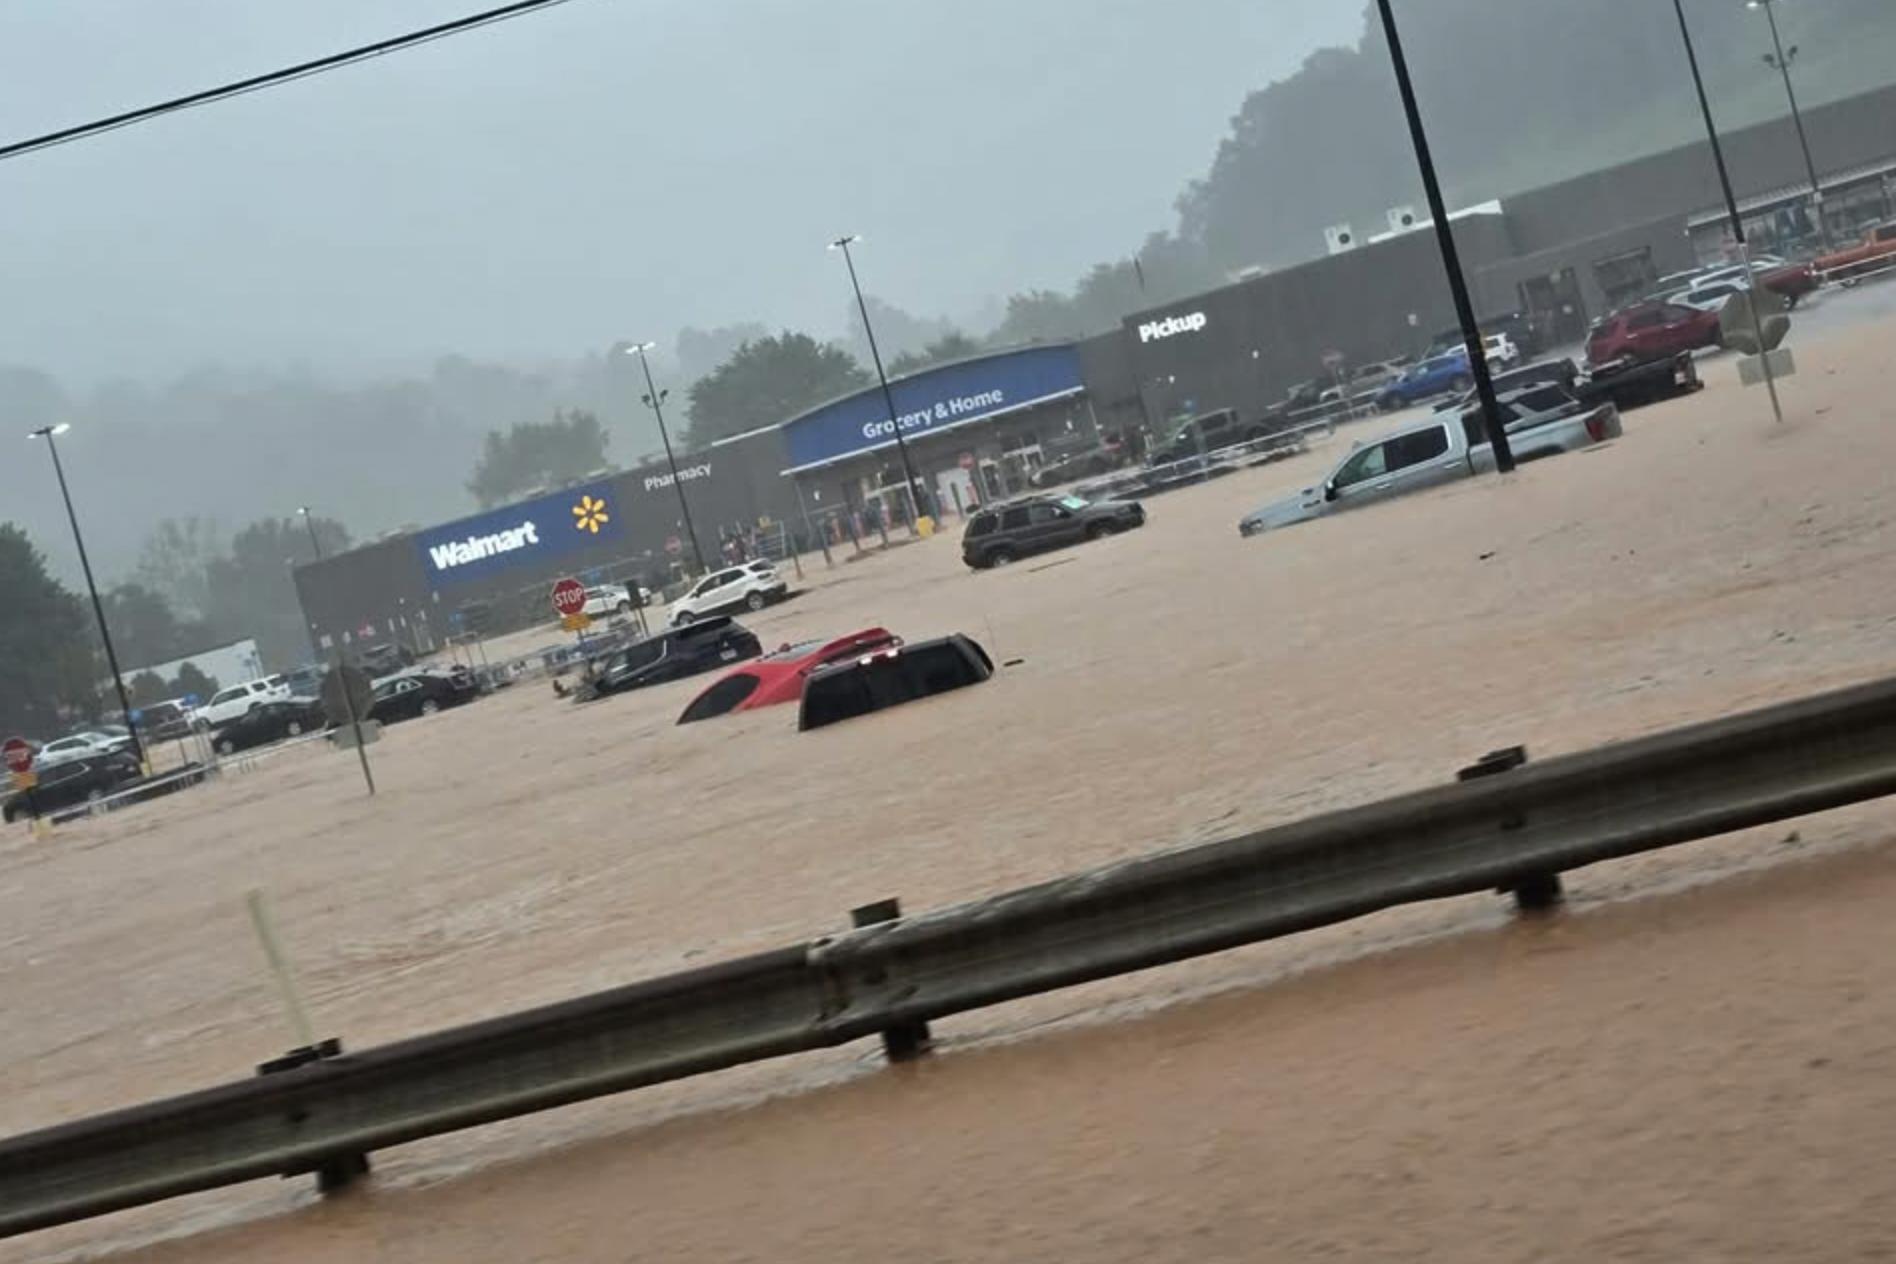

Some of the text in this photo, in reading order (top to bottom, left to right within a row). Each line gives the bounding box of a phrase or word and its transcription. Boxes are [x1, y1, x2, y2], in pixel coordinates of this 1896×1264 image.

[1138, 312, 1206, 343] Pickup
[862, 389, 1004, 438] Grocery & Home
[644, 463, 711, 491] Pharmacy
[429, 521, 539, 570] Walmart
[555, 587, 583, 607] STOP
